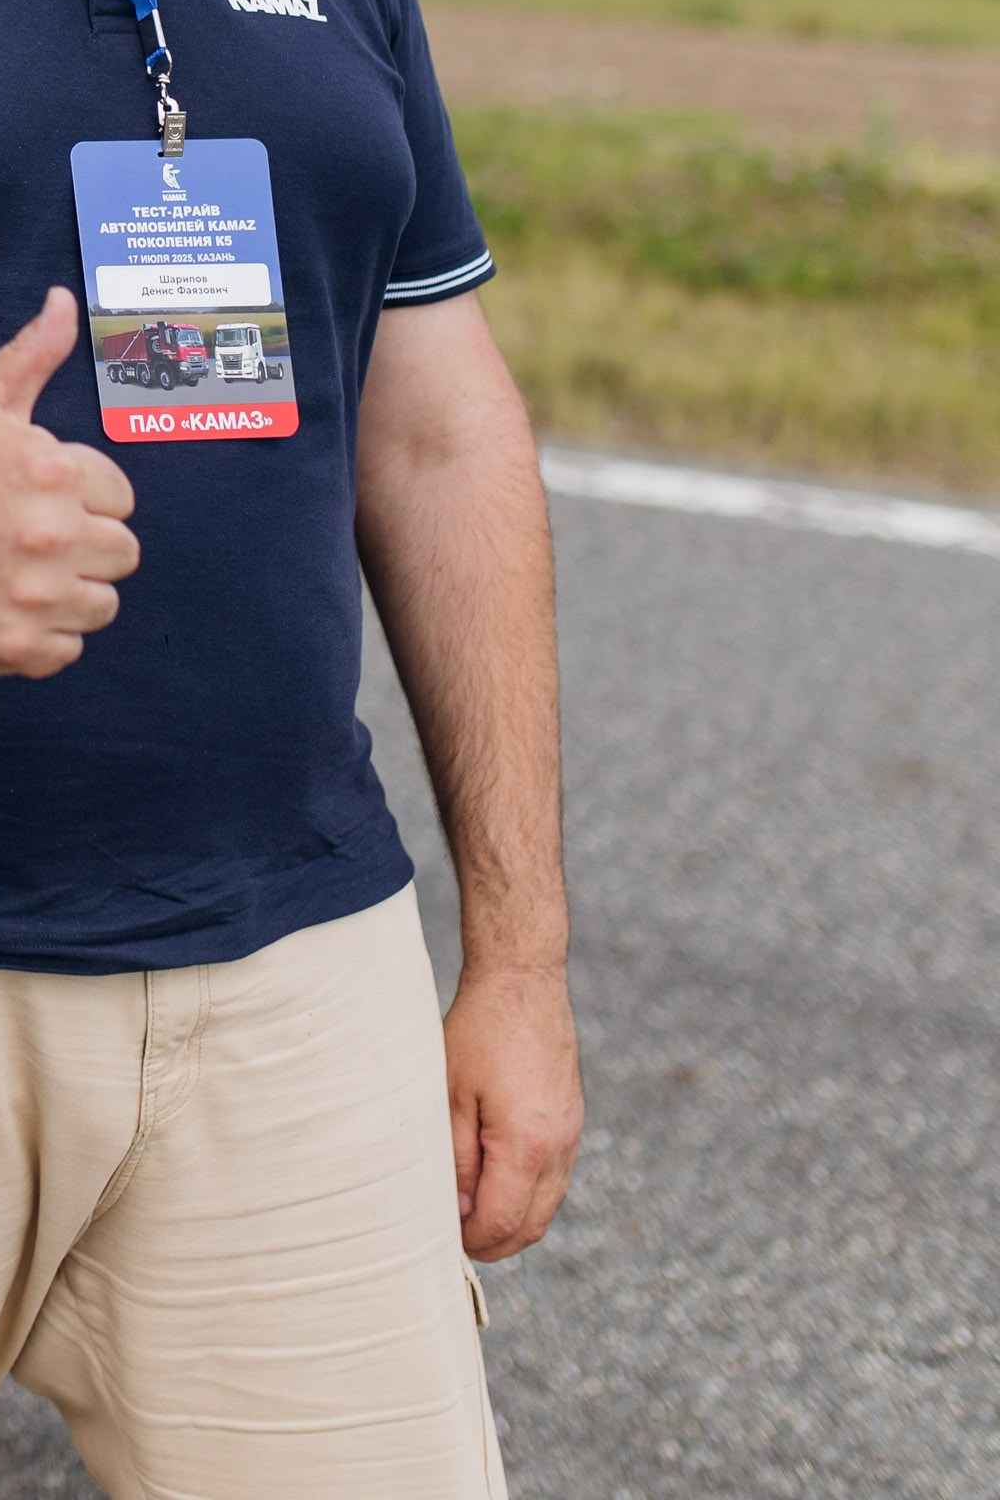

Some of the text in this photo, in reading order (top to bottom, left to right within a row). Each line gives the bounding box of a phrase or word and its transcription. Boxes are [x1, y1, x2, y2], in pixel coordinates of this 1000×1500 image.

[132, 204, 220, 219] ТЕСТ-ДРАЙВ
[100, 219, 257, 234] АВТОМОБИЛЕЙ KAMAZ
[127, 236, 212, 248] ПОКОЛЕНИЯ
[128, 253, 236, 264] 17 ИЮЛЯ 2025, КАЗАНЬ
[159, 275, 208, 285] Шарипов
[141, 286, 228, 297] Денис Фаязович
[129, 410, 273, 433] ПАО «КАМАЗ»
